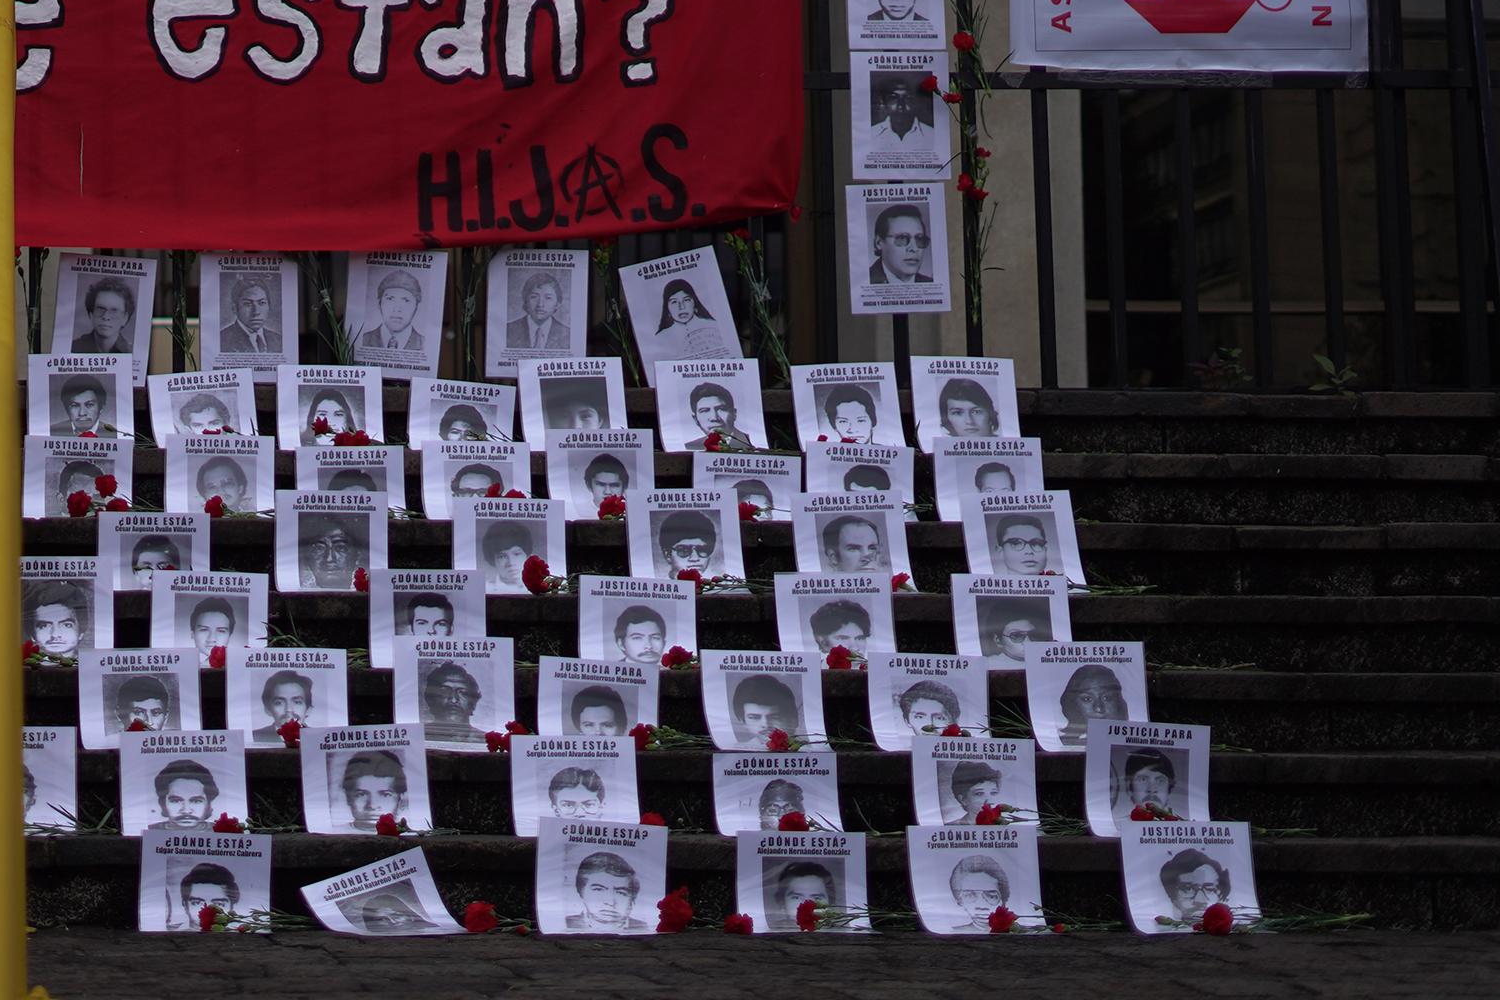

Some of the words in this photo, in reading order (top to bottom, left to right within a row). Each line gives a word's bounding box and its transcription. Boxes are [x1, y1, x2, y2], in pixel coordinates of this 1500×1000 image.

[296, 494, 336, 506] ¿DÓNDE
[340, 494, 371, 506] ESTÁ?
[172, 575, 214, 587] ¿DÓNDE
[218, 576, 251, 587] ESTÁ?
[599, 580, 648, 593] JUSTICIA
[652, 582, 679, 593] PARA
[972, 578, 1013, 590] ¿DÓNDE
[1017, 578, 1049, 589] ESTÁ?
[1107, 725, 1159, 739] JUSTICIA
[1164, 728, 1192, 739] PARA
[562, 824, 609, 839] ¿DÓNDE
[608, 827, 648, 840] ESTÁ?
[931, 830, 977, 842] ¿DÓNDE
[981, 829, 1017, 842] ESTÁ?
[1142, 826, 1196, 838] JUSTICIA
[1201, 826, 1230, 837] PARA
[164, 836, 211, 850] ¿DÓNDE
[216, 837, 252, 849] ESTÁ?
[759, 835, 805, 848] ¿DÓNDE
[811, 835, 846, 848] ESTÁ?
[326, 871, 369, 894] ¿DÓNDE
[371, 858, 412, 878] ESTÁ?
